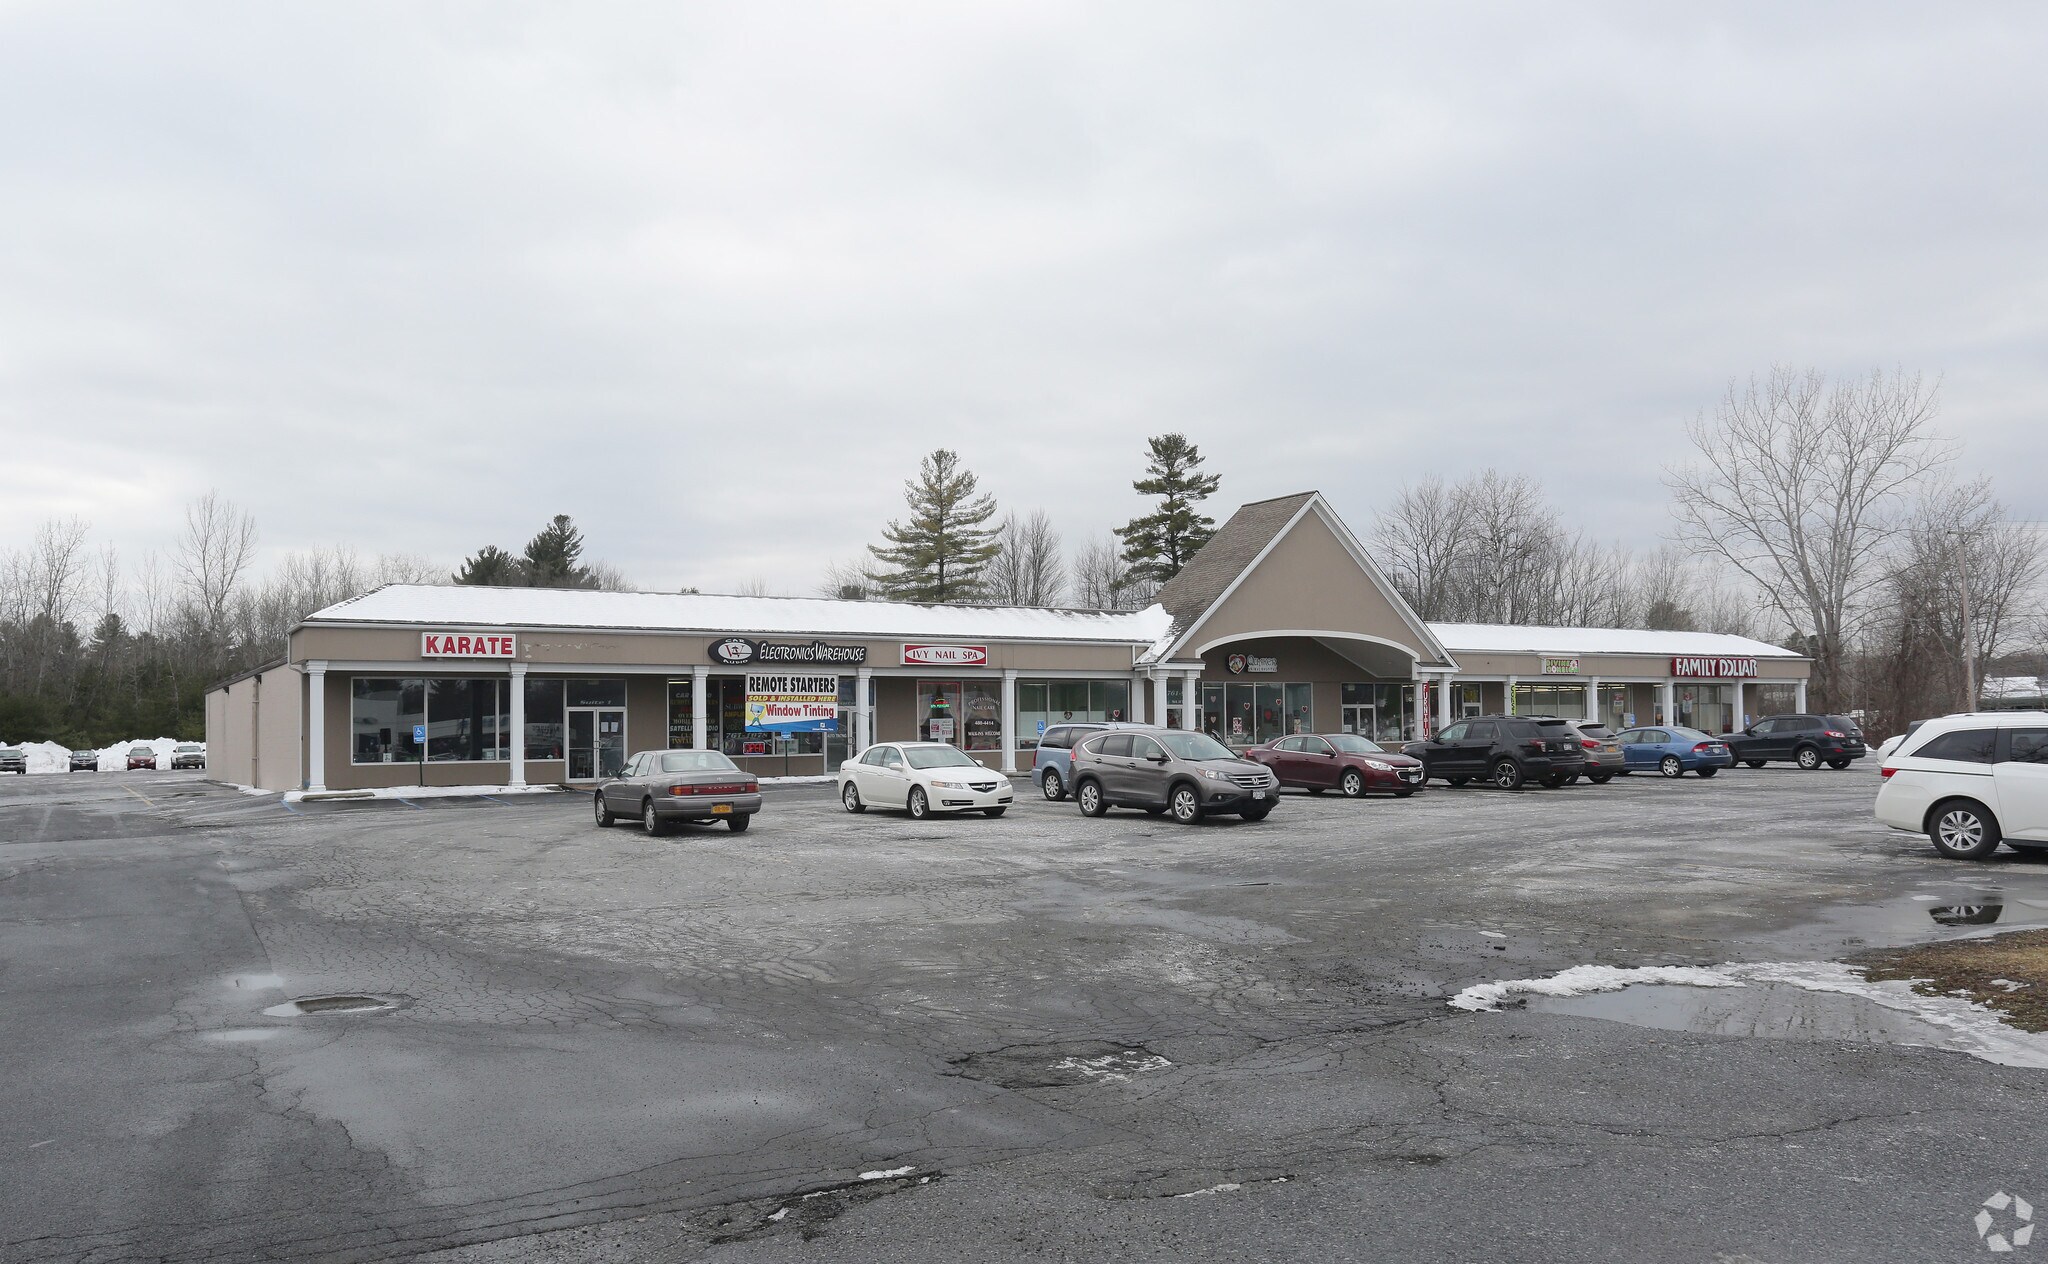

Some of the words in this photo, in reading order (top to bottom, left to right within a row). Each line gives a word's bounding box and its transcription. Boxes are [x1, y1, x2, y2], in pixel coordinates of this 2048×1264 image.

[425, 635, 513, 655] KARATE
[912, 650, 929, 659] IVY
[935, 650, 957, 659] NAIL
[962, 651, 978, 660] SPA
[1675, 658, 1717, 676] FAMILY
[1719, 658, 1758, 676] DOLLAR
[749, 676, 788, 693] REMOTE
[790, 676, 836, 693] STARTERS
[765, 704, 802, 717] Window
[803, 704, 835, 720] Tinting
[745, 743, 764, 752] OPEN
